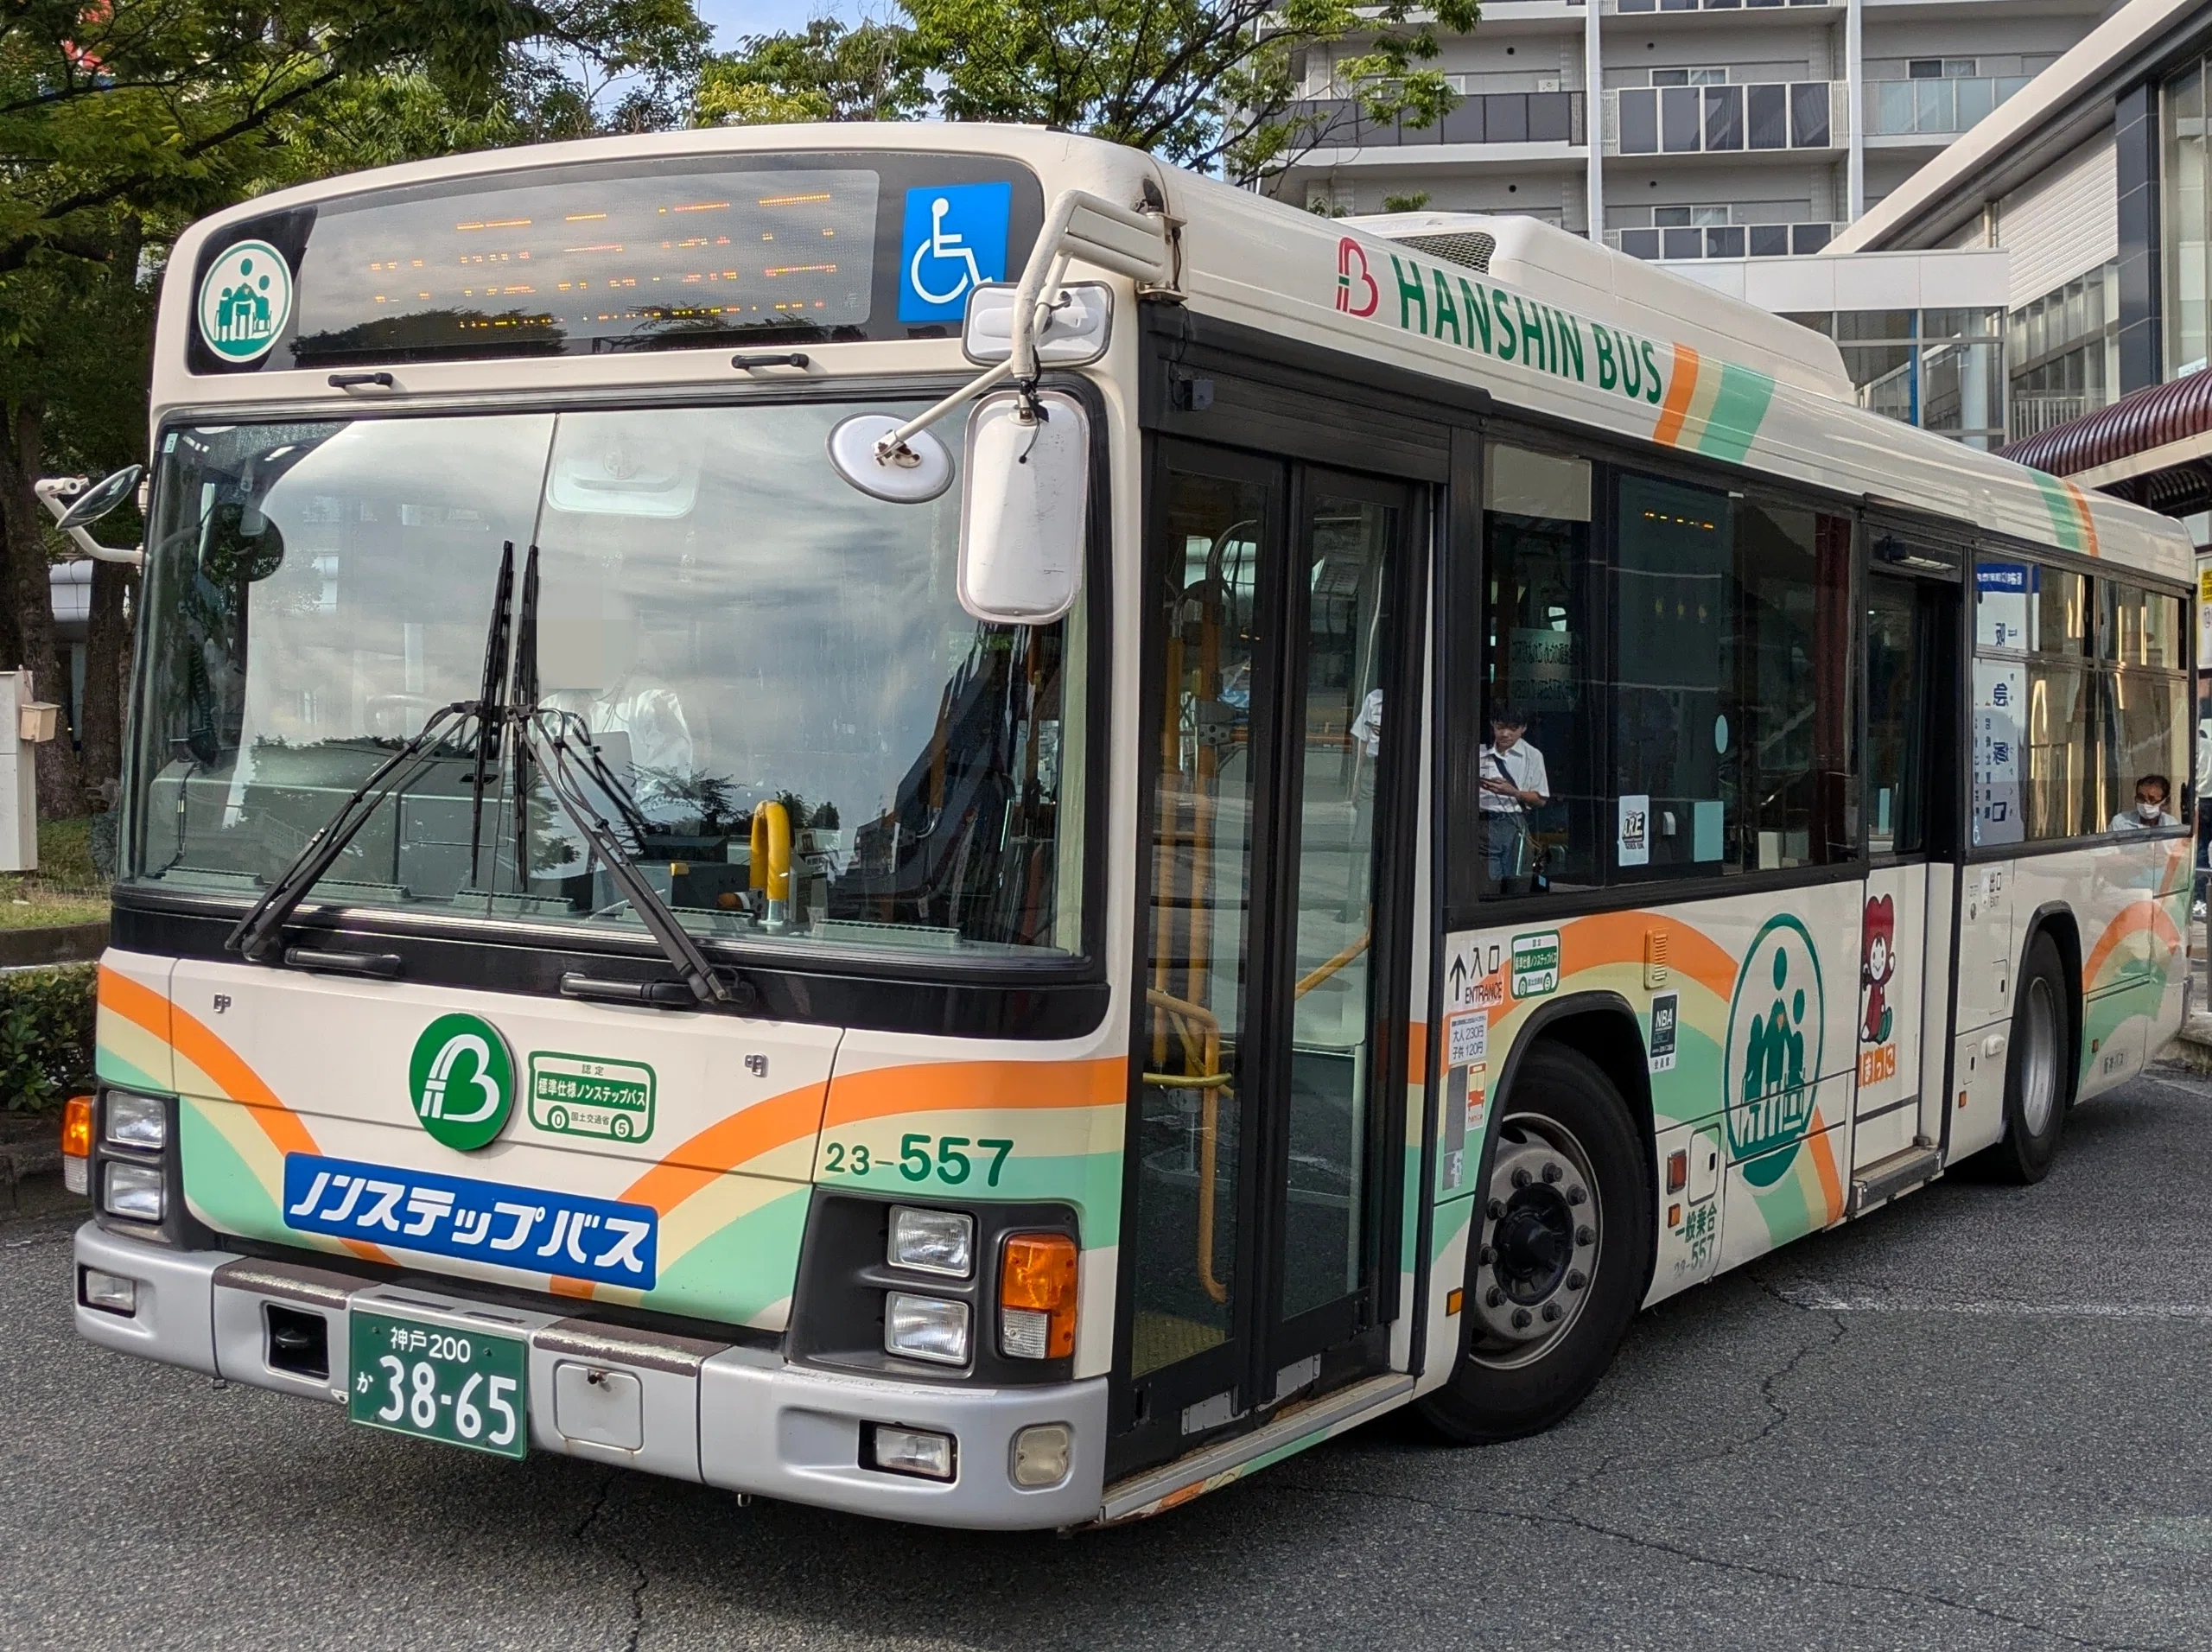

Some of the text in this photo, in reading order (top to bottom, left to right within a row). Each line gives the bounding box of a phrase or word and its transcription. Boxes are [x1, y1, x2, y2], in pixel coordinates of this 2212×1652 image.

[1389, 253, 1662, 404] HANSHIN BUS
[1470, 944, 1500, 980] 入口
[1465, 982, 1503, 1004] ENTRANCE
[1656, 1008, 1673, 1028] NBA
[1465, 1025, 1484, 1040] 230円
[1465, 1041, 1484, 1056] 120円
[582, 1064, 605, 1077] 認定
[537, 1077, 646, 1107] 標準仕様ノンステップバス
[570, 1111, 611, 1126] 国土交通省
[618, 1122, 626, 1135] 5
[824, 1133, 1014, 1187] 23-557
[289, 1172, 651, 1274] ノンステップバス
[356, 1370, 374, 1395] か
[378, 1354, 517, 1446] 38-65
